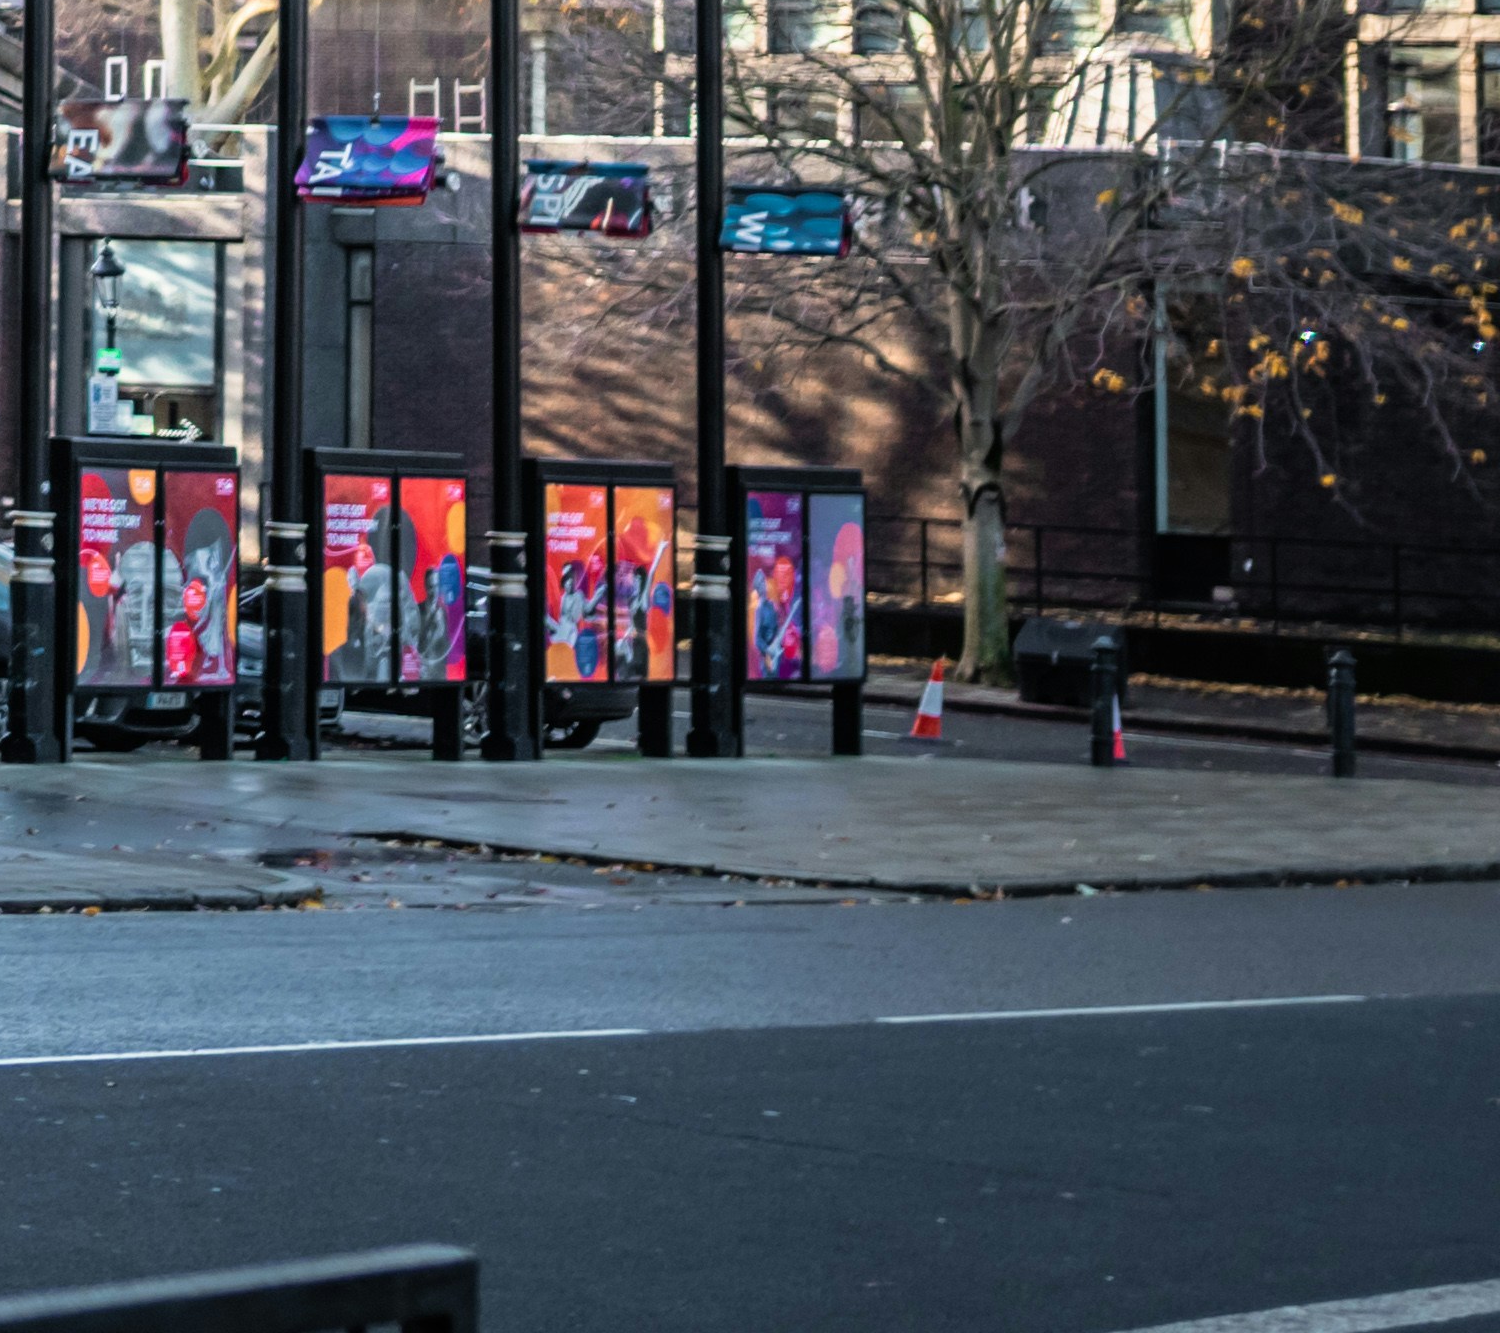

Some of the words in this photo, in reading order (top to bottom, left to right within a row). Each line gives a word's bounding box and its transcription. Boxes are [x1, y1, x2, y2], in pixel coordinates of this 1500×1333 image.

[110, 497, 127, 512] GOT
[83, 513, 107, 528] MORE
[108, 513, 141, 528] HISTORY
[83, 529, 96, 543] TO
[97, 529, 119, 543] MAKE
